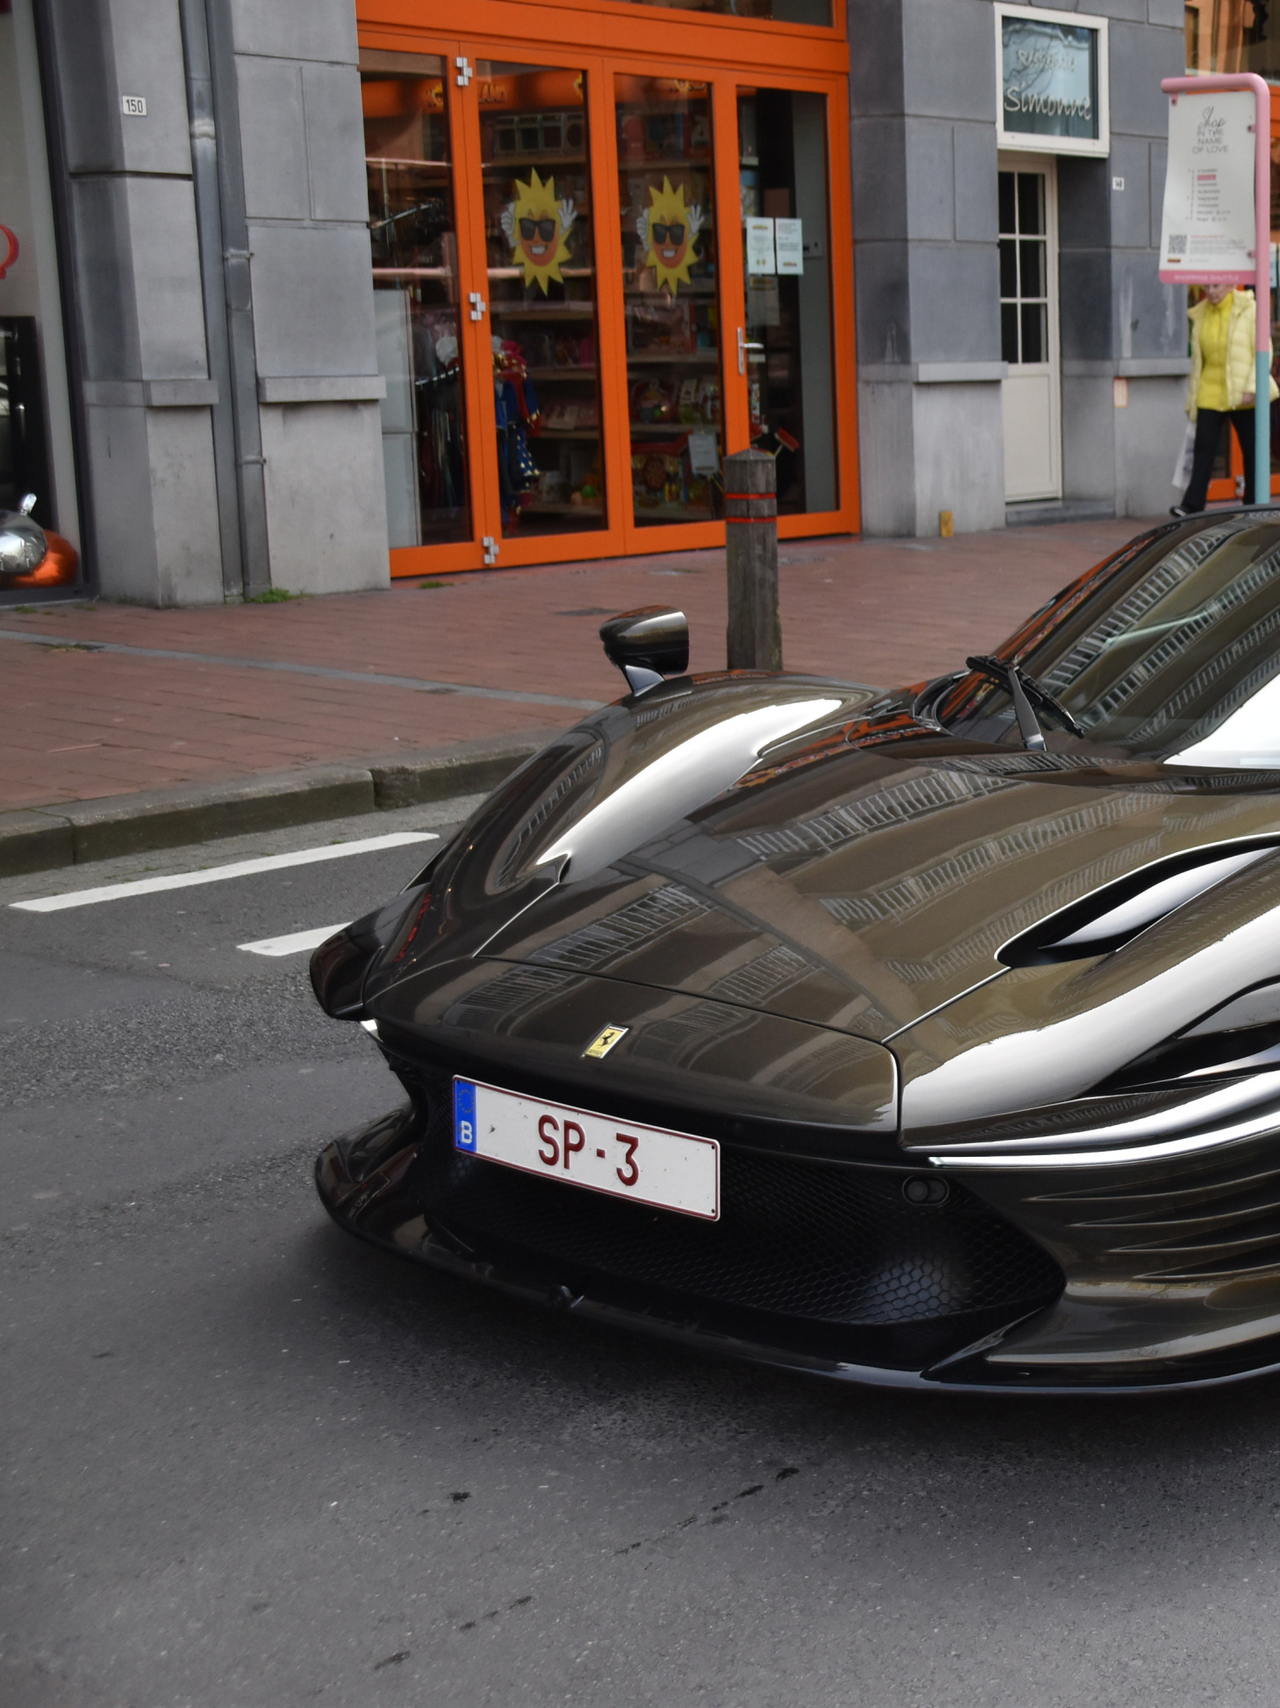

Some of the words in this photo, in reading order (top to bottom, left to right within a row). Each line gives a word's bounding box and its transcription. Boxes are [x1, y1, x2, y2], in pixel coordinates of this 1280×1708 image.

[126, 99, 144, 113] 150
[1003, 82, 1092, 120] Simonne
[1198, 106, 1227, 136] Shop
[1192, 146, 1204, 154] OF
[1206, 145, 1229, 154] LOVE
[460, 1120, 474, 1145] B
[538, 1114, 640, 1187] SP-3
